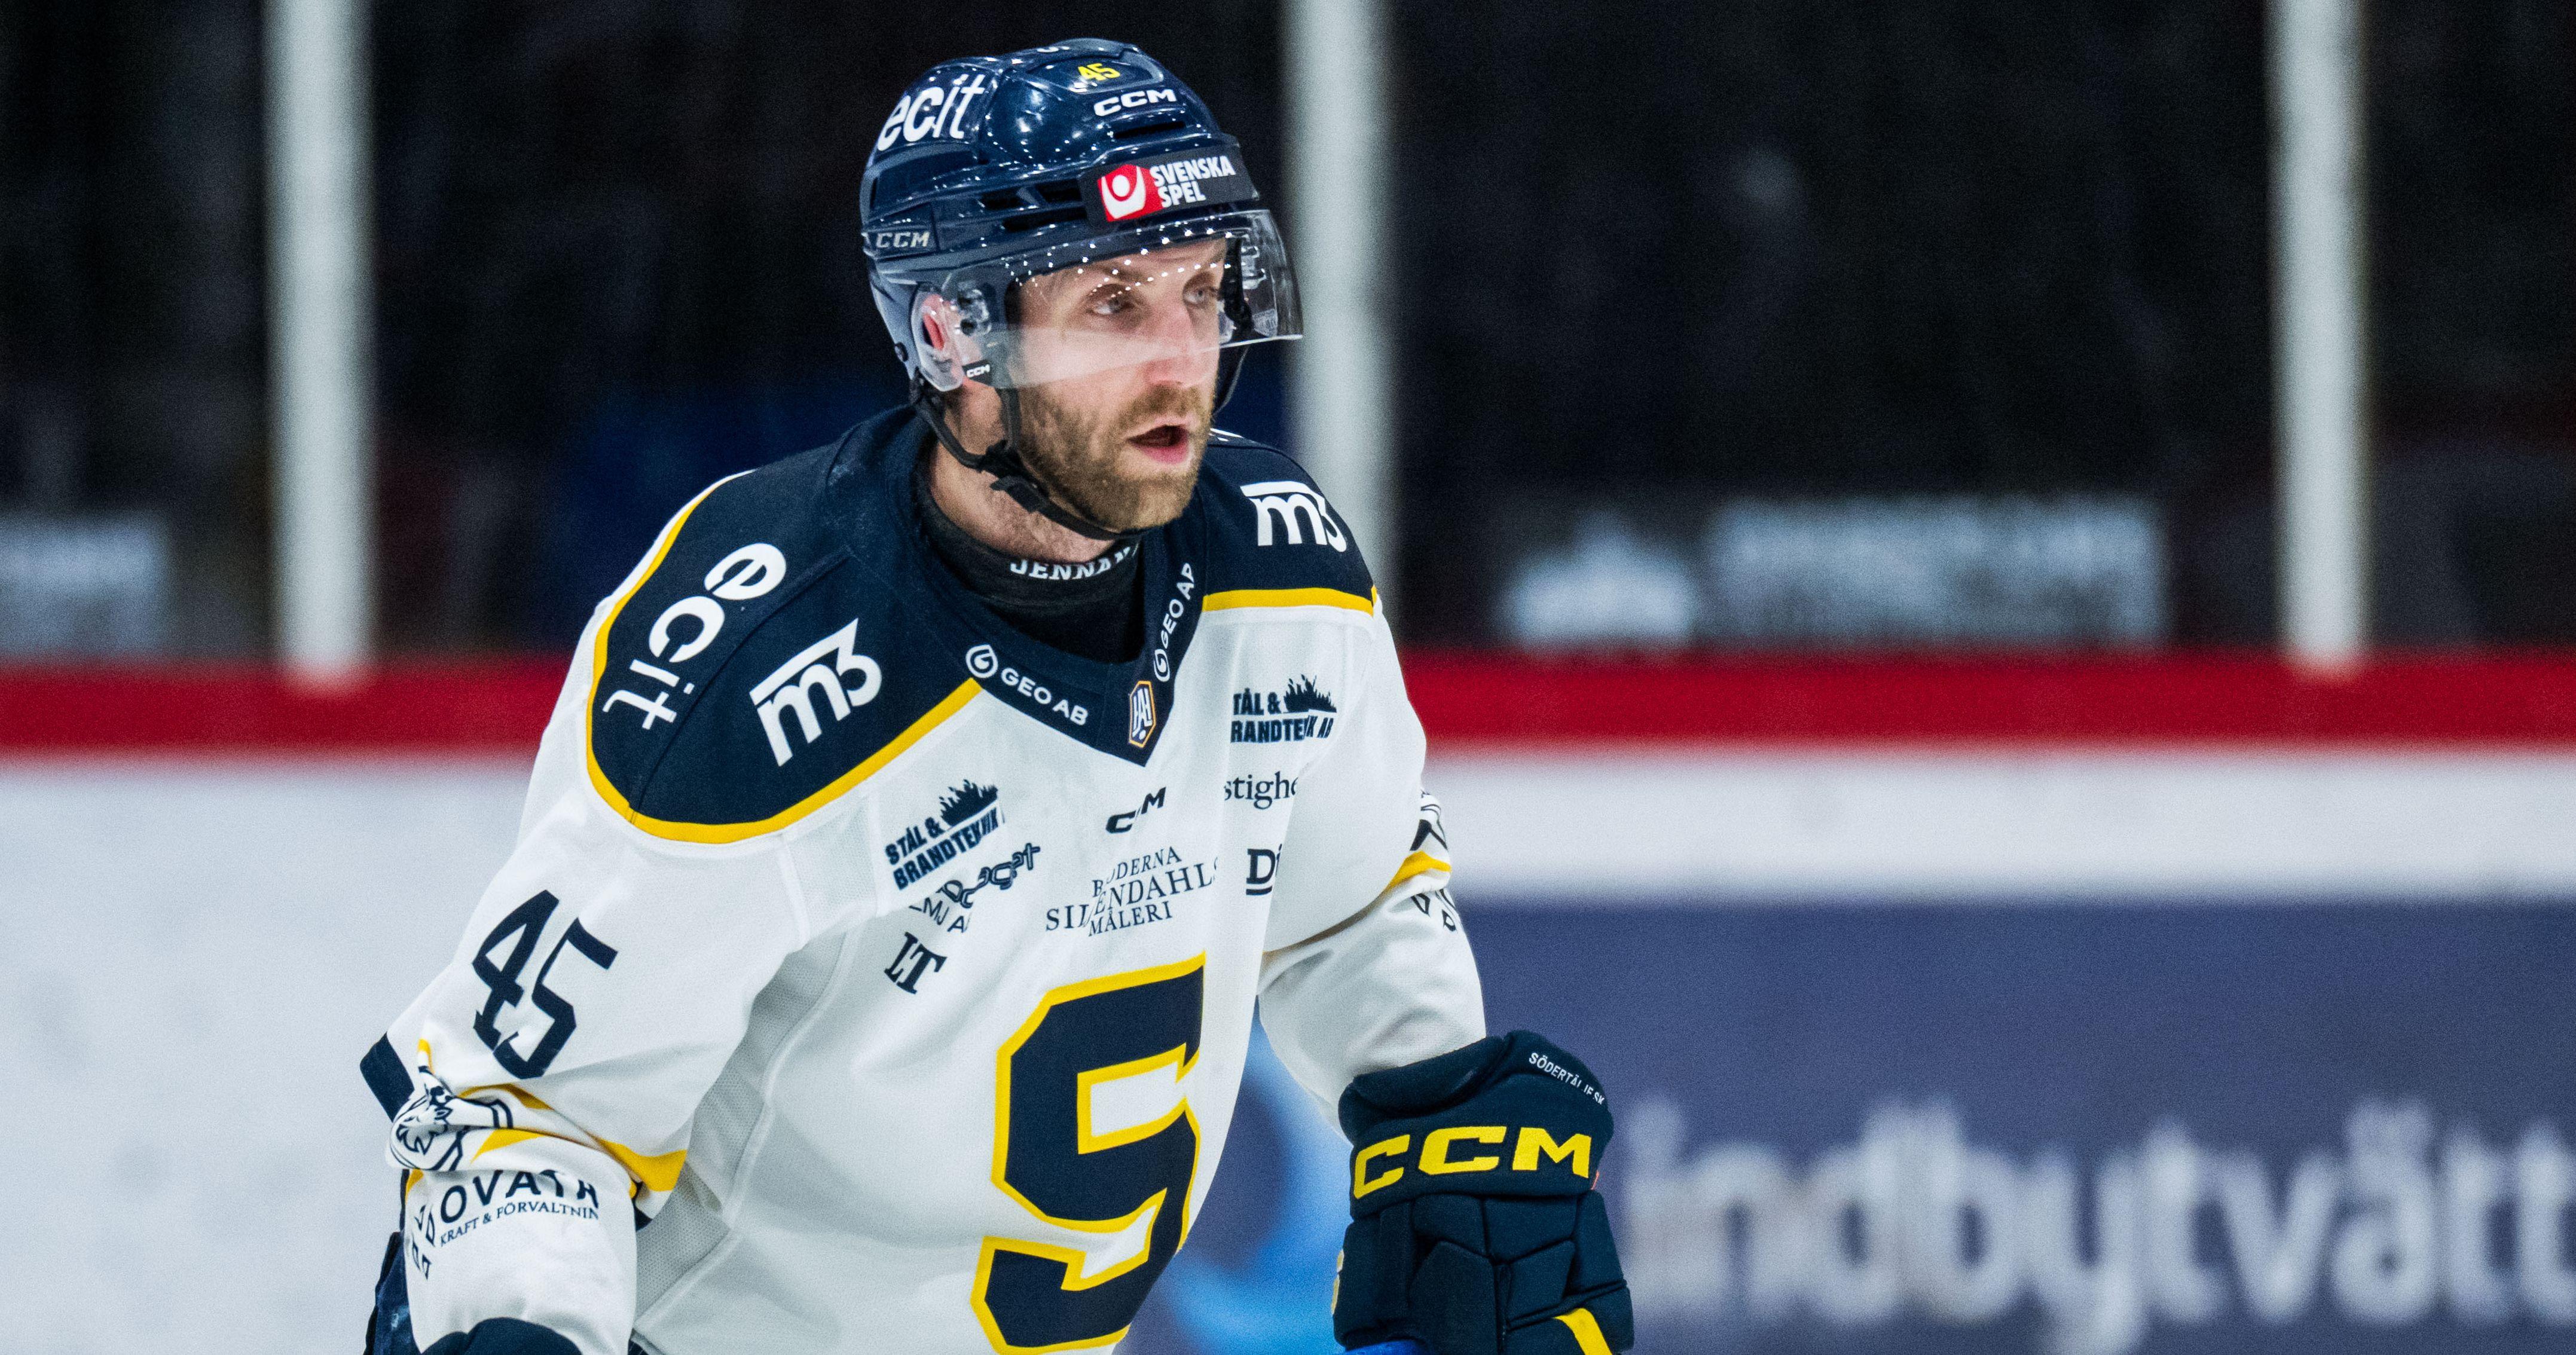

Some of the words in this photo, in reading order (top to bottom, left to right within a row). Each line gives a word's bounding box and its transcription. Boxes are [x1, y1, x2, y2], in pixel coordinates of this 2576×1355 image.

[1077, 63, 1121, 81] 45
[877, 73, 986, 152] ecit
[1093, 88, 1178, 117] CCM
[1148, 155, 1237, 188] SVENSKA
[1157, 181, 1207, 208] SPEL
[875, 231, 931, 249] CCM
[966, 363, 991, 378] CCM
[601, 542, 787, 730] ecit
[1161, 598, 1185, 649] GEO
[1000, 666, 1052, 705] GEO
[1052, 699, 1089, 726] AB
[1267, 691, 1282, 715] &
[1105, 786, 1167, 834] CM
[885, 825, 928, 865] STÅL
[924, 816, 946, 839] &
[1088, 900, 1174, 937] MÅLERI
[884, 931, 948, 995] LT
[471, 889, 619, 1081] 45
[1352, 1125, 1592, 1200] CCM
[440, 1216, 479, 1247] KRAFT
[482, 1212, 492, 1225] &
